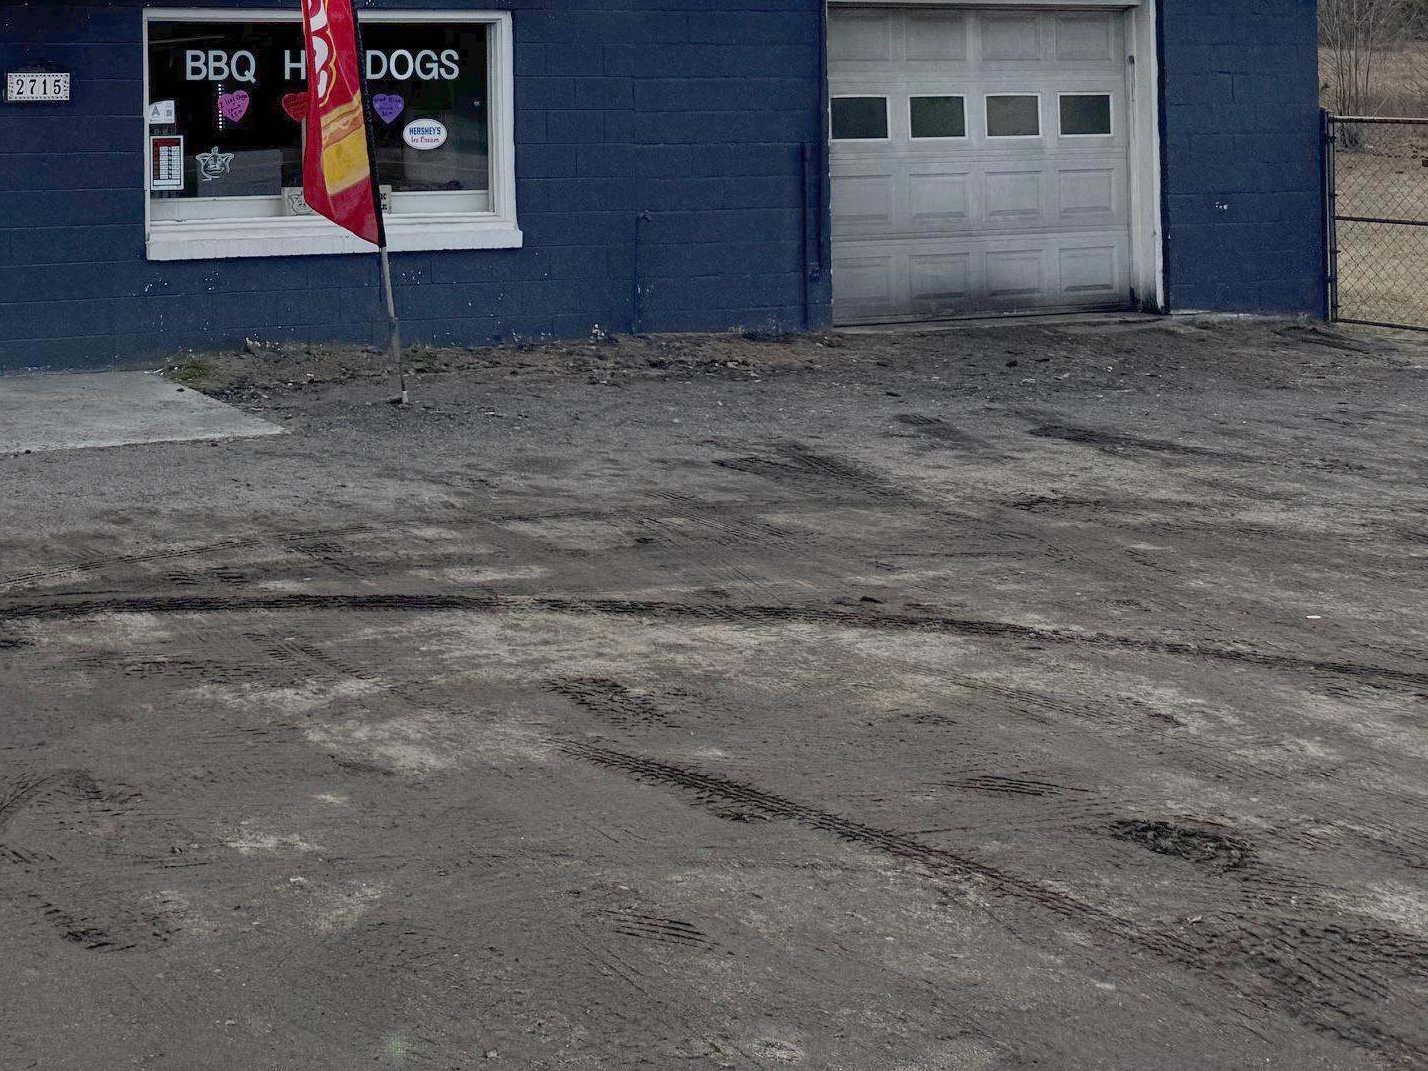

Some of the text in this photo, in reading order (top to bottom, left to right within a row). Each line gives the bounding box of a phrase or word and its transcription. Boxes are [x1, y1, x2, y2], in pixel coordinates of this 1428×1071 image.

[185, 49, 257, 83] BBQ
[365, 49, 460, 81] DOGS
[16, 78, 62, 96] 2715
